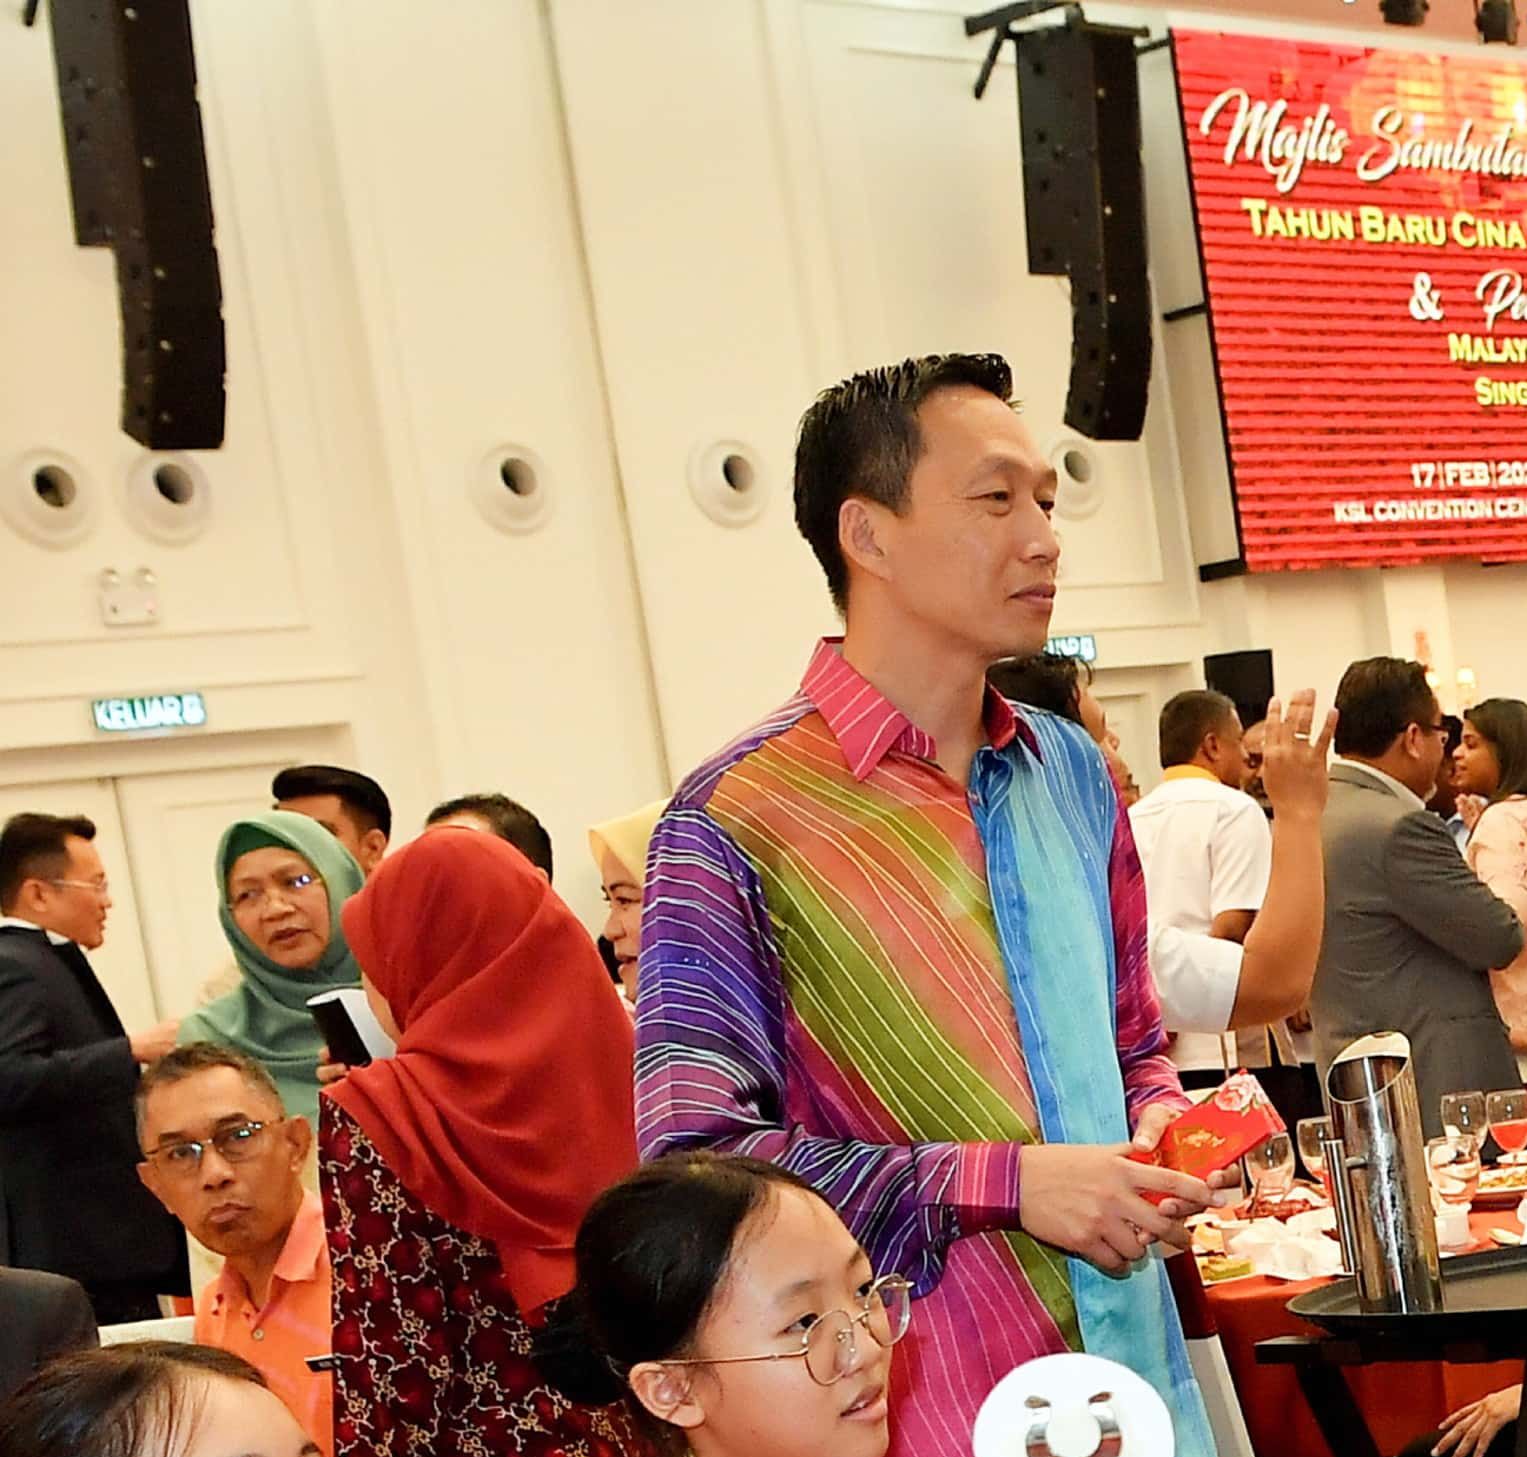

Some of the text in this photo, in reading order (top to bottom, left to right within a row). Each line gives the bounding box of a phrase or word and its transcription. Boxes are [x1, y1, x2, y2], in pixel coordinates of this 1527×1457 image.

[1200, 88, 1350, 193] Majlis
[1241, 198, 1527, 250] TAHUN BARU CINA
[1409, 271, 1444, 320] &
[1333, 501, 1373, 522] KSL
[1373, 499, 1495, 521] CONVENTION
